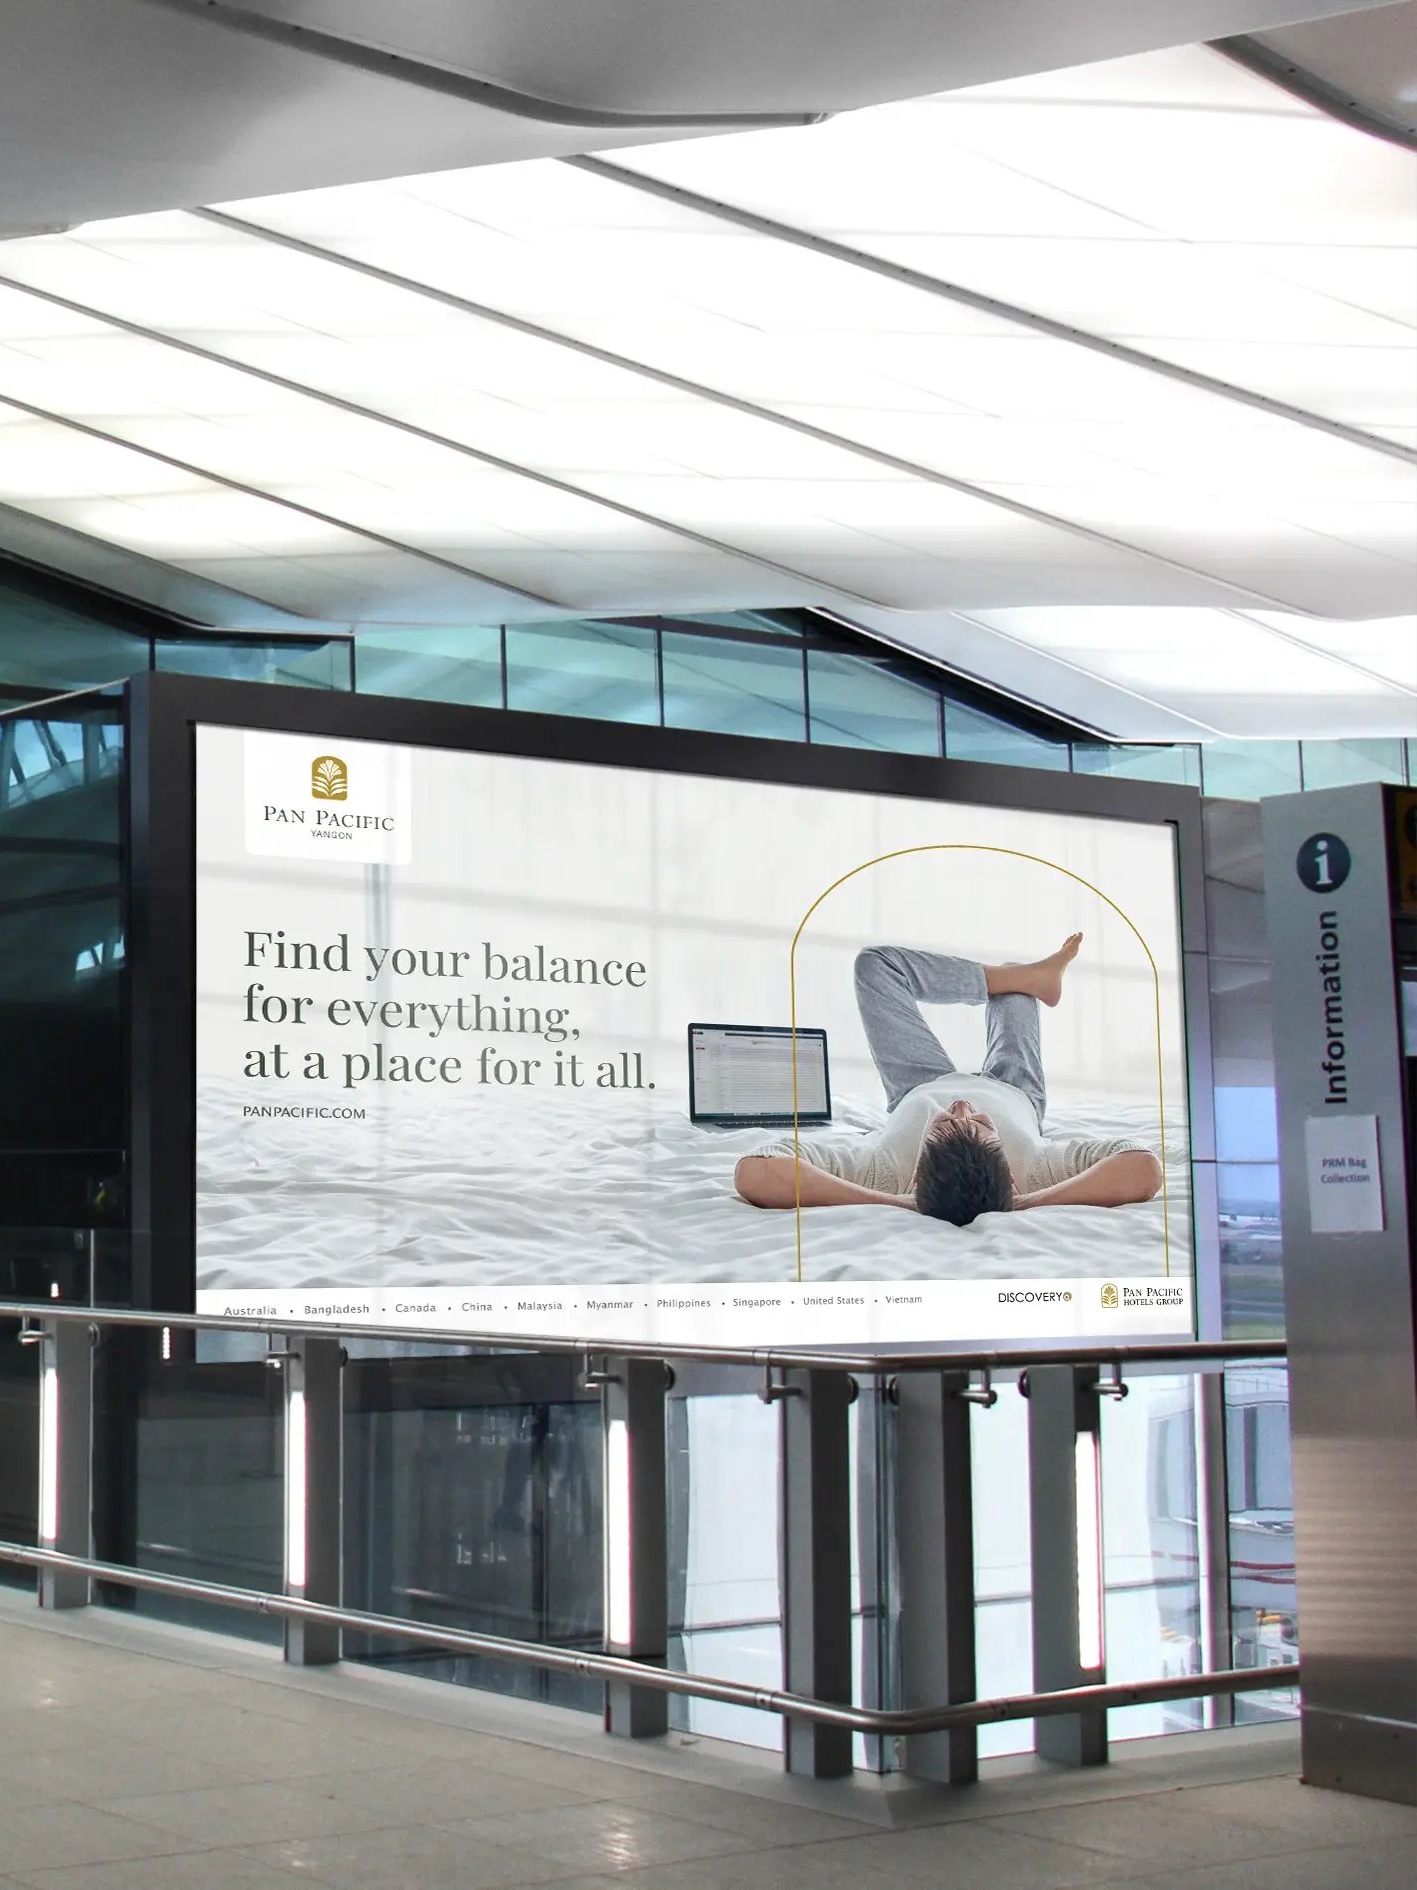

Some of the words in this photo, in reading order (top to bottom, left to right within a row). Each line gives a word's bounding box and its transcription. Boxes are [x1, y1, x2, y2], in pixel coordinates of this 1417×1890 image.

[263, 805, 305, 824] PAN
[316, 809, 395, 831] PACIFIC
[311, 829, 353, 840] YANGON
[243, 930, 352, 972] Find
[363, 947, 471, 982] your
[481, 941, 647, 988] balance
[243, 982, 314, 1025] for
[327, 993, 580, 1043] everything,
[1315, 910, 1348, 1105] Information
[243, 1044, 290, 1079] at
[303, 1052, 329, 1080] a
[341, 1042, 462, 1089] place
[477, 1046, 542, 1086] for
[553, 1049, 585, 1088] it
[596, 1051, 656, 1090] all.
[243, 1105, 366, 1120] PANPACIFIC.COM
[1322, 1157, 1345, 1167] PRM
[1320, 1174, 1370, 1183] Collection
[998, 1291, 1063, 1303] DISCOVERY
[1122, 1287, 1142, 1298] PAN
[1146, 1287, 1183, 1297] PACIFIC
[223, 1306, 277, 1316] Australia
[304, 1303, 370, 1317] Bangladesh
[395, 1303, 437, 1313] Canada
[461, 1302, 493, 1312] China
[517, 1301, 563, 1312] Malaysia
[586, 1300, 634, 1311] Myanmar
[656, 1298, 711, 1309] Philippines
[732, 1298, 782, 1309] Singapore
[803, 1296, 834, 1306] United
[836, 1296, 865, 1305] States
[885, 1295, 923, 1304] Vietnam
[1123, 1298, 1154, 1306] HOTELS
[1155, 1297, 1184, 1306] GROUP
